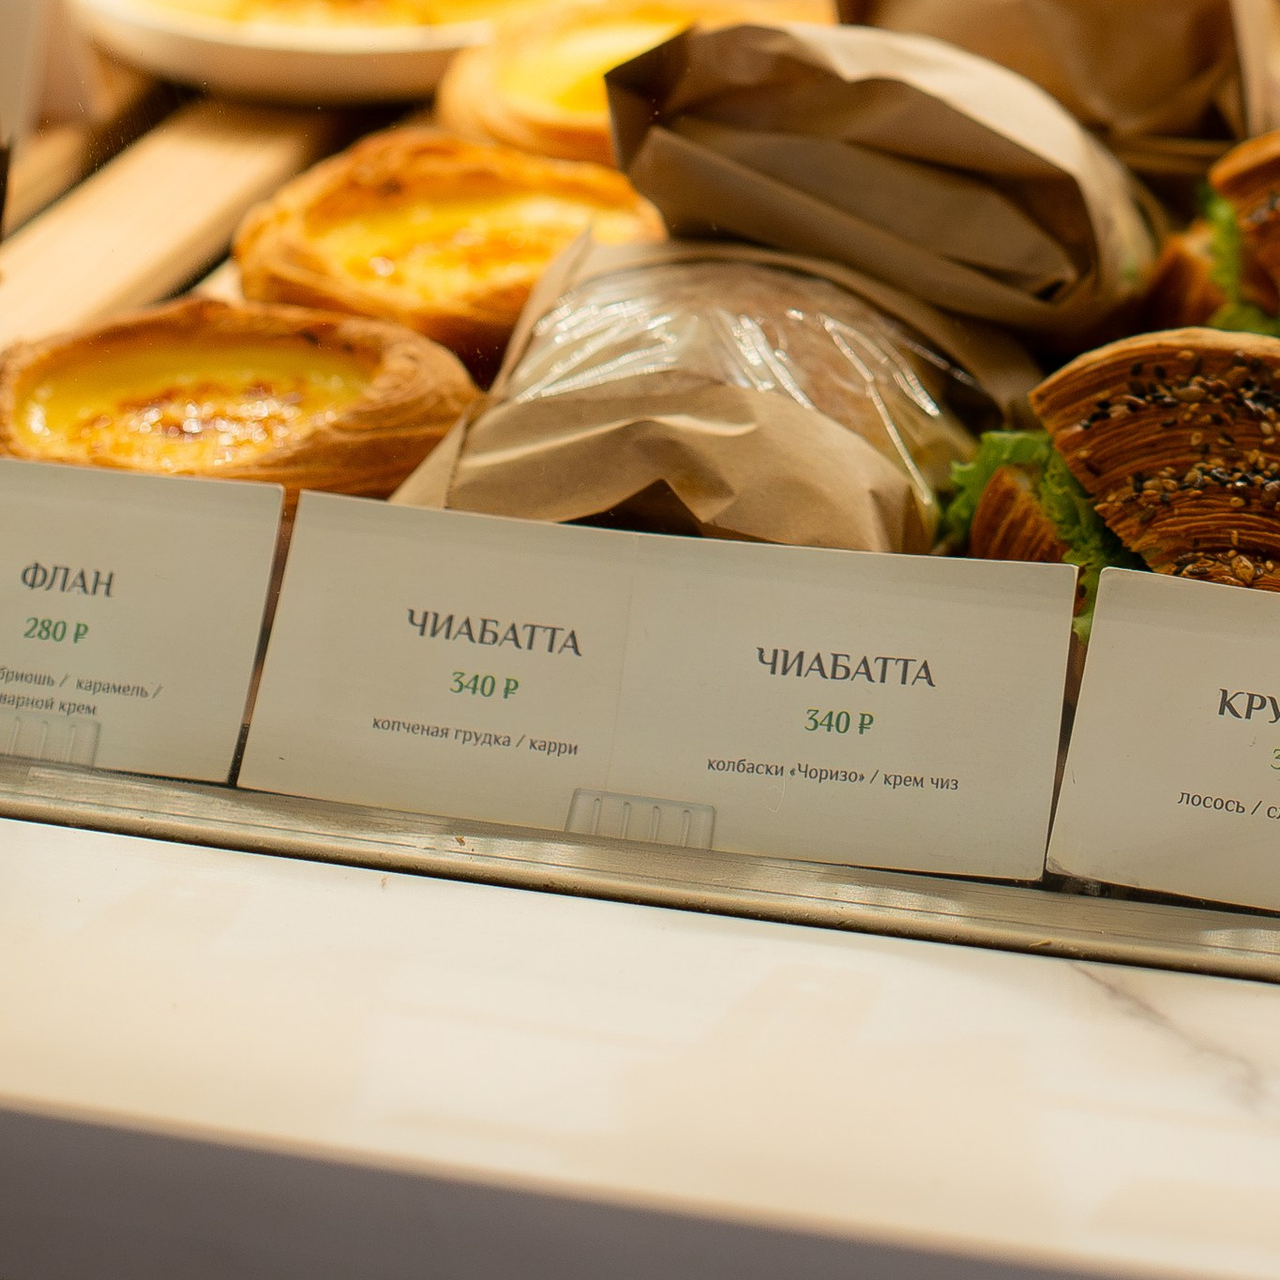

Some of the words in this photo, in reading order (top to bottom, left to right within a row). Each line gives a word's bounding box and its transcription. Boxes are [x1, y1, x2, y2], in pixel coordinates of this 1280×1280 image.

[21, 562, 114, 598] ФЛАН
[24, 617, 66, 642] 280
[408, 608, 582, 656] ЧИАБАТТА
[756, 647, 935, 687] ЧИАБАТТА
[76, 677, 149, 698] карамель
[450, 672, 495, 697] 340
[59, 701, 97, 716] крем
[804, 709, 850, 734] 340
[372, 717, 449, 739] копченая
[454, 727, 511, 746] грудка
[529, 738, 578, 756] карри
[707, 759, 784, 776] колбаски
[790, 763, 864, 783] «Чоризо»
[884, 773, 924, 789] крем
[930, 777, 959, 790] чиз
[1178, 792, 1245, 813] лосось
